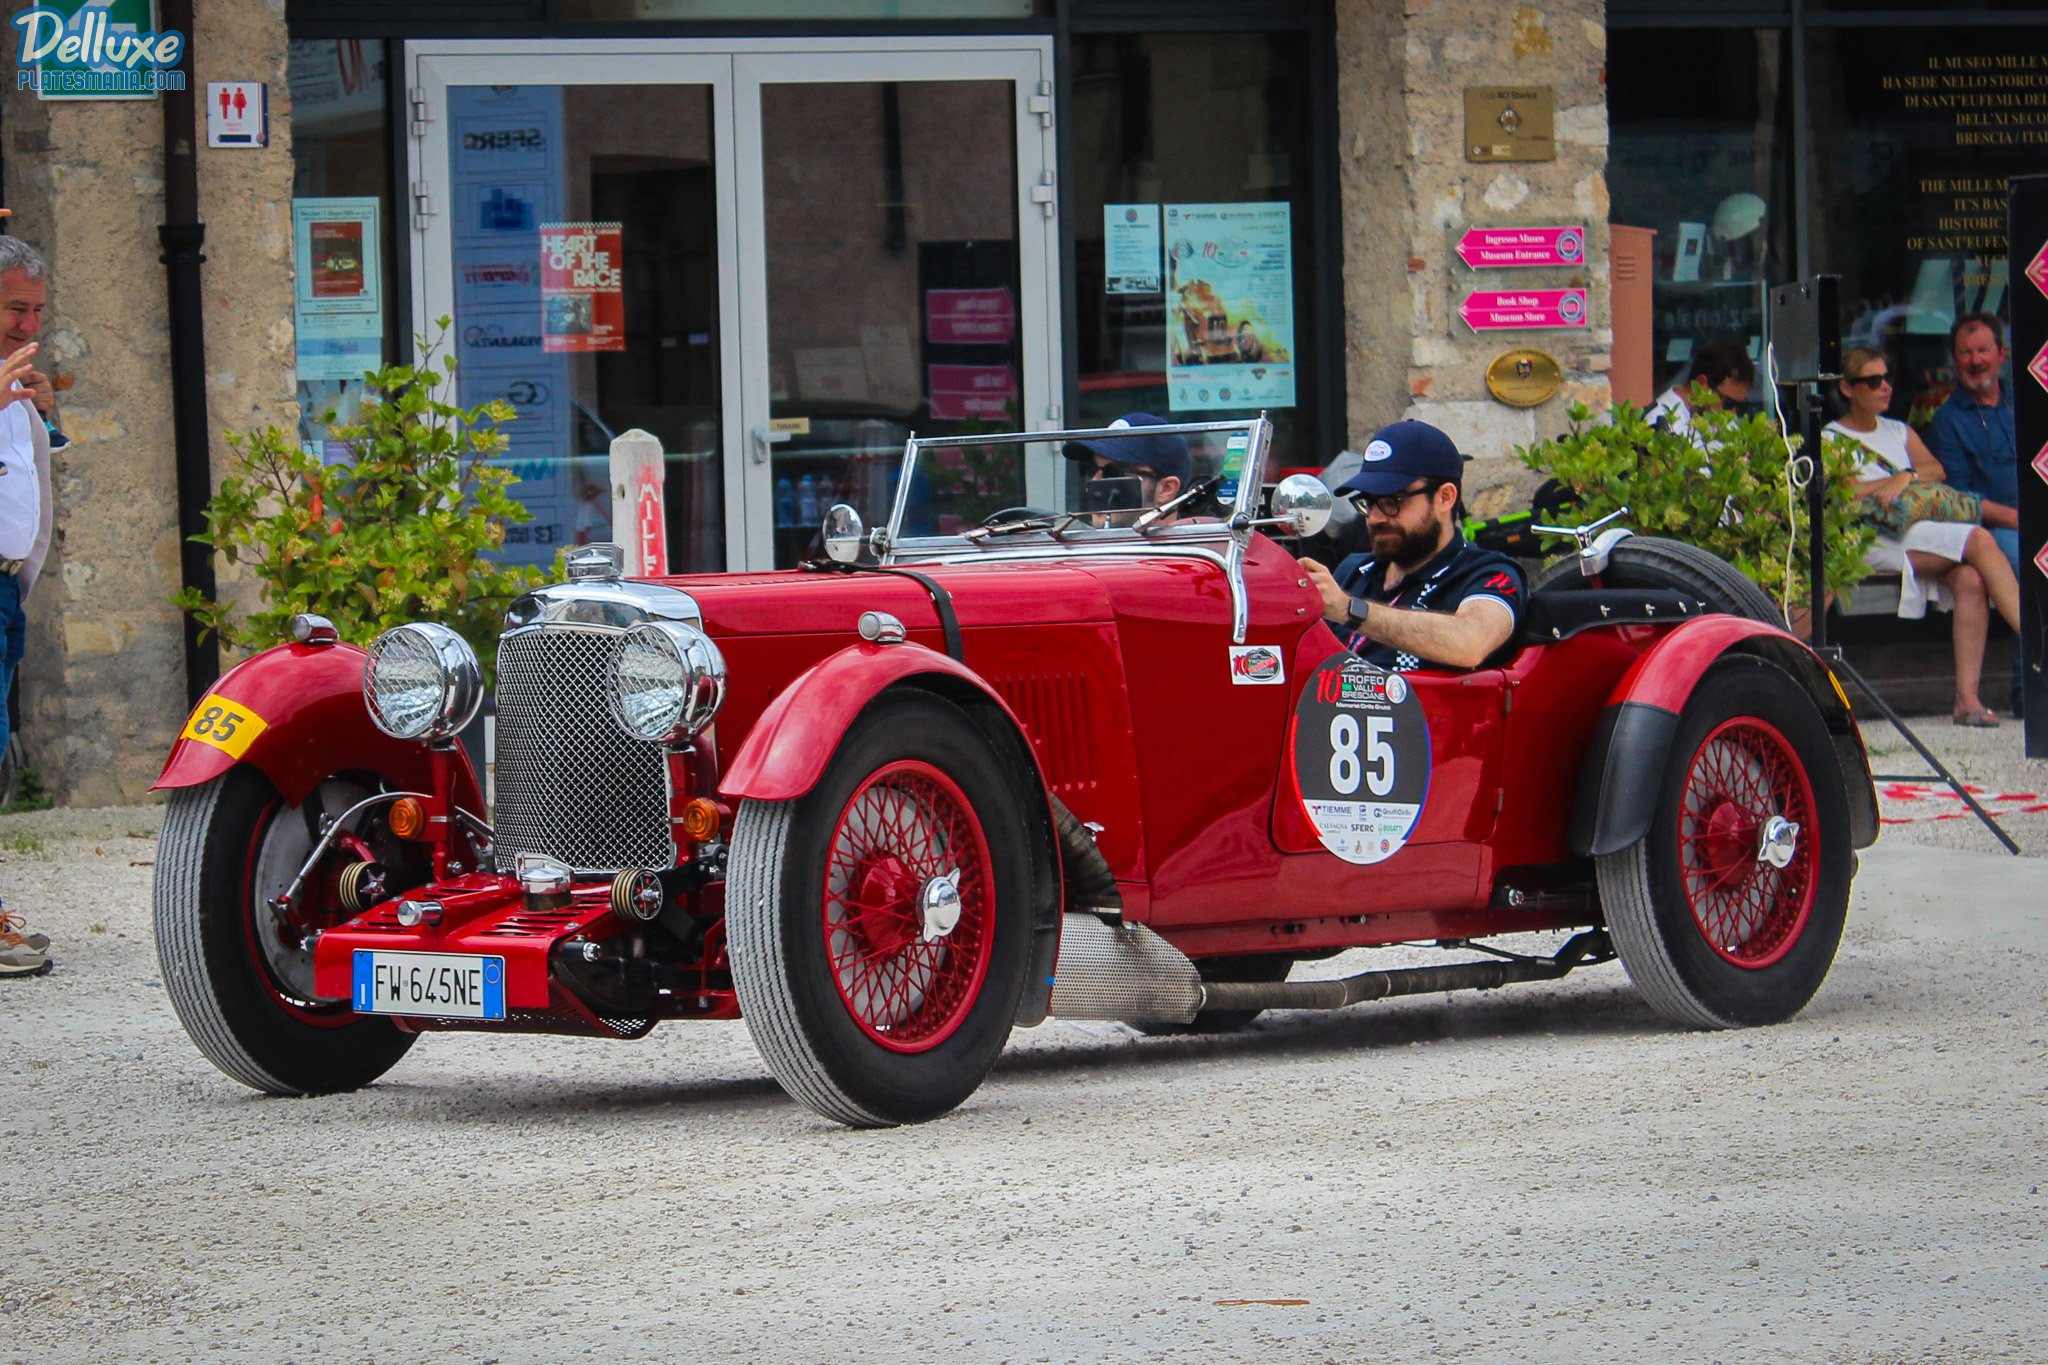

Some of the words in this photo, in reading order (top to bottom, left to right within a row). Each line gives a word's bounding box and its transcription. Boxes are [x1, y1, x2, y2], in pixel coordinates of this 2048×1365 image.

[1929, 57, 1941, 69] IL
[1945, 56, 1992, 69] MUSEO
[1995, 56, 2037, 68] MILLE
[1883, 76, 1901, 89] HA
[1904, 76, 1938, 88] SEDE
[1942, 75, 1987, 88] NELLO
[1904, 95, 1919, 108] DI
[1922, 94, 2021, 107] SANT'EUFEMIA
[1956, 132, 2012, 145] BRESCIA
[1920, 180, 1945, 193] THE
[1950, 179, 1993, 192] MILLE
[1954, 199, 1980, 211] IT'S
[1939, 218, 2002, 230] HISTORIC
[541, 235, 597, 253] HEART
[1485, 234, 1517, 245] Ingresso
[1519, 233, 1545, 243] Museo
[1907, 238, 1924, 250] OF
[549, 252, 576, 270] OF
[579, 251, 609, 269] THE
[1480, 251, 1514, 260] Museum
[1515, 250, 1551, 259] Entrance
[573, 269, 621, 287] RACE
[1496, 297, 1517, 306] Book
[1518, 296, 1539, 307] Shop
[1490, 313, 1523, 322] Museum
[1524, 312, 1546, 321] Store
[1341, 674, 1385, 685] TROFEO
[1353, 684, 1374, 692] VALLI
[1341, 691, 1385, 700] BRESCIANE
[194, 706, 245, 741] 85
[1329, 713, 1395, 797] 85
[1322, 805, 1352, 814] TIEMME
